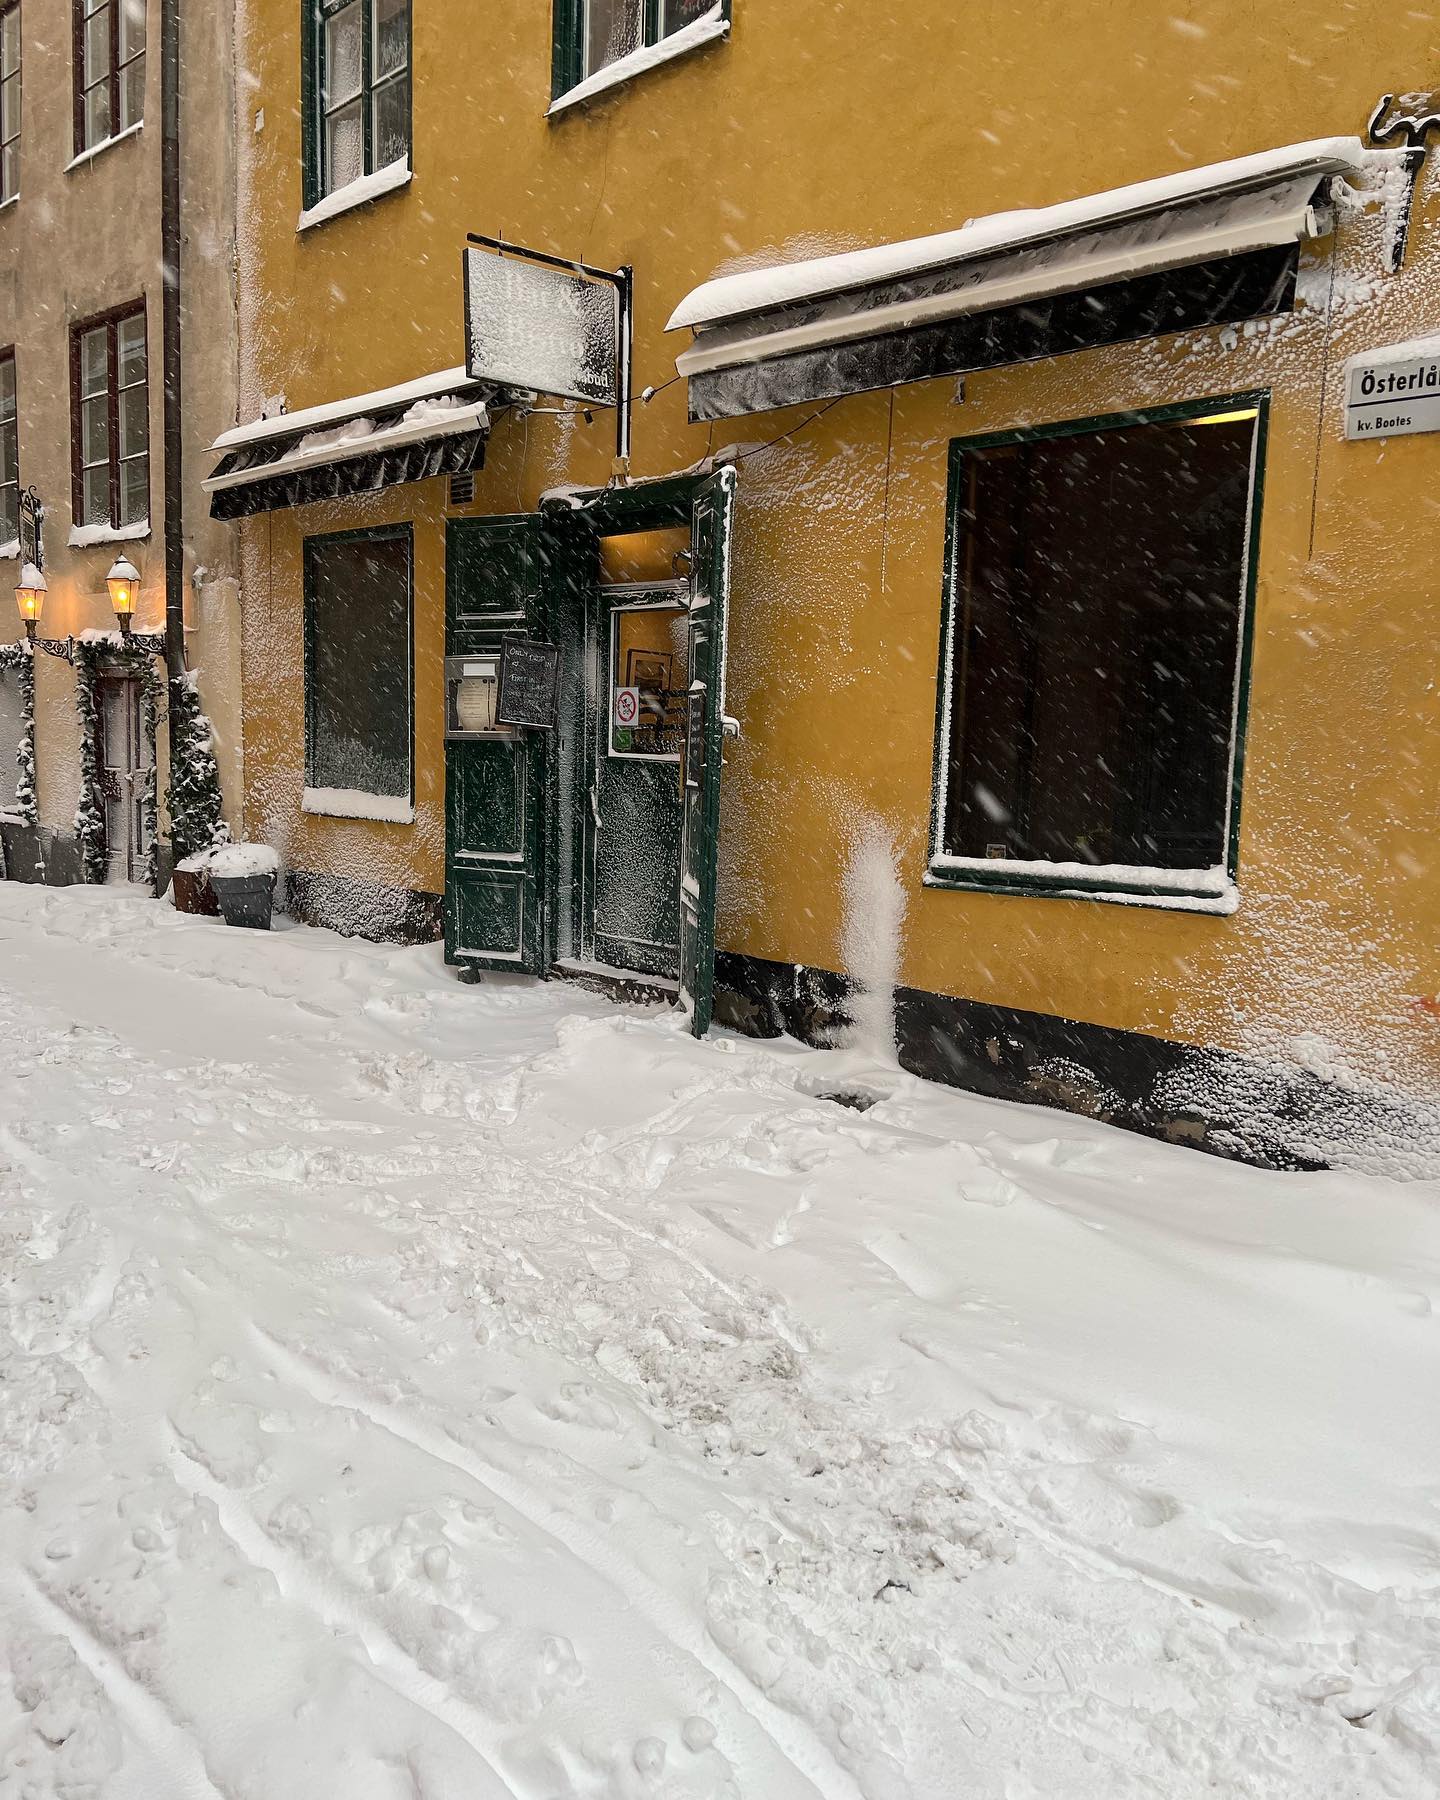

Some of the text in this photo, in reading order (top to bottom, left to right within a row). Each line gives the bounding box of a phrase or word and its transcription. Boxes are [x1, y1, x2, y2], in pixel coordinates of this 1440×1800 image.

[1361, 365, 1440, 395] Österlå
[1357, 416, 1412, 431] kv. Bootes
